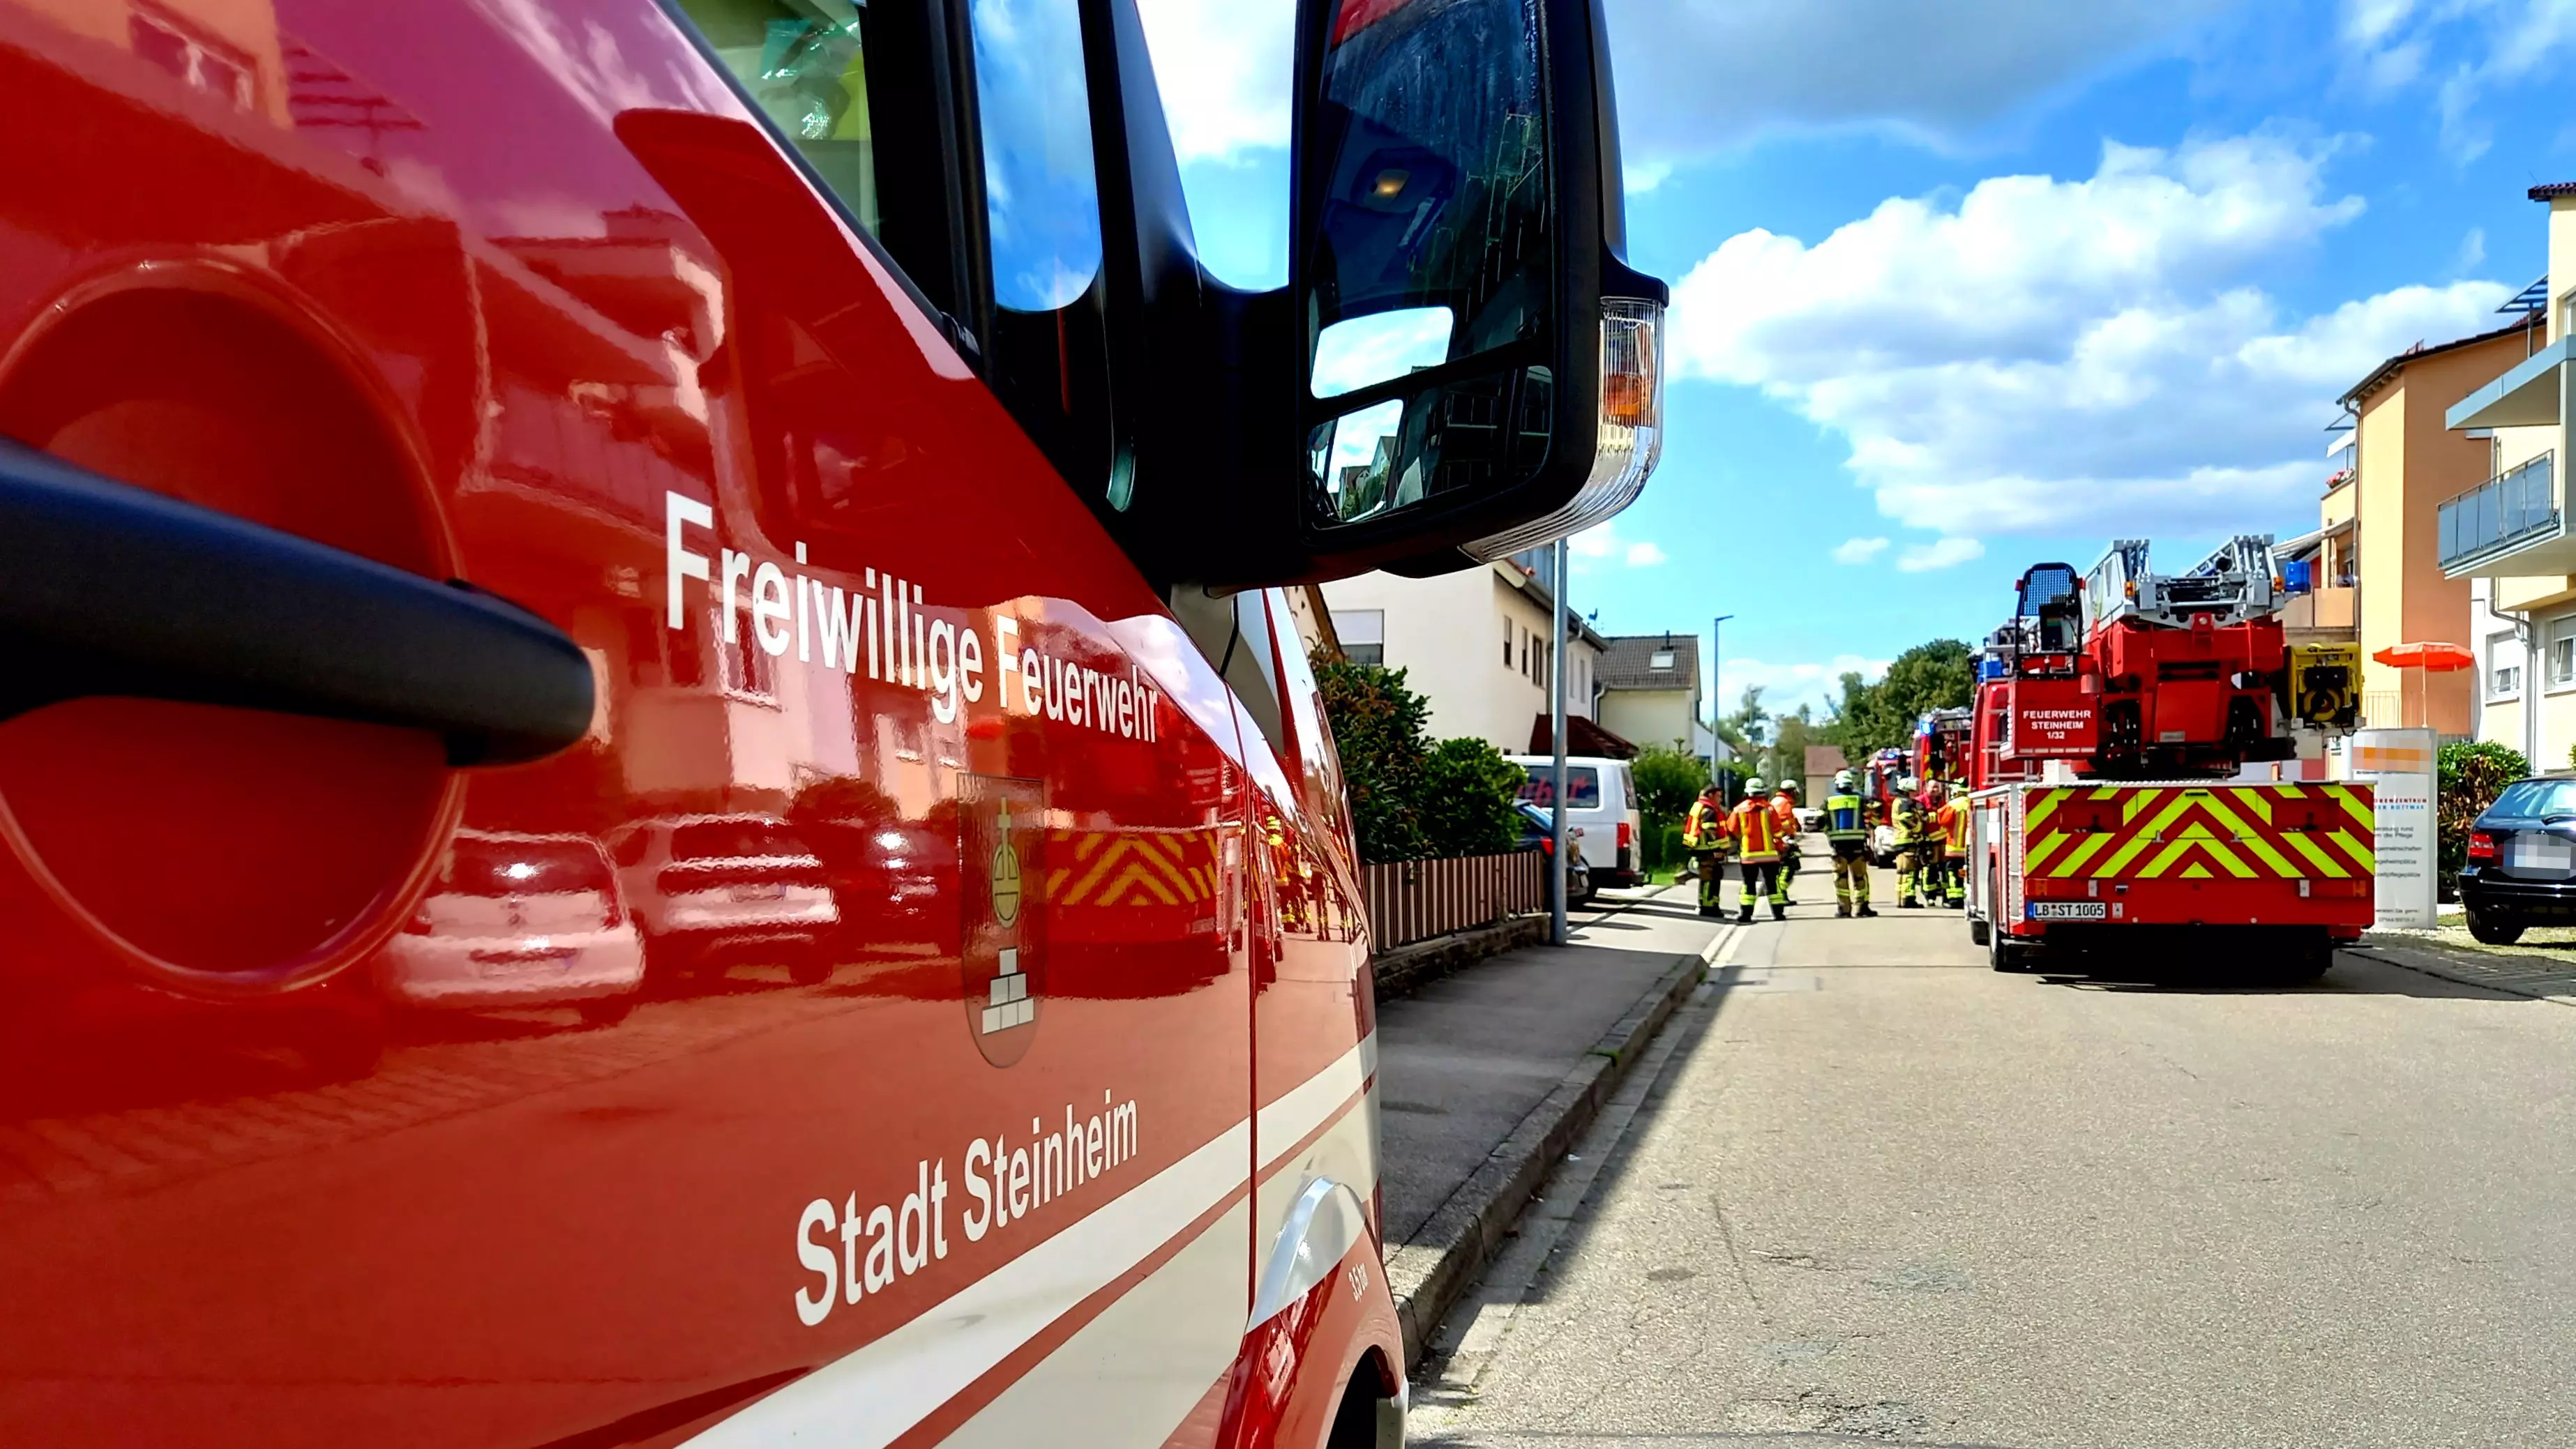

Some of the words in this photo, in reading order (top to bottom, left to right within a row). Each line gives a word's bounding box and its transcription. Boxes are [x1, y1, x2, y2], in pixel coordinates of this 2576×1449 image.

[665, 490, 984, 724] Freiwillige
[995, 614, 1159, 743] Feuerwehr
[2023, 710, 2091, 719] FEUERWEHR
[2031, 721, 2084, 730] STEINHEIM
[2047, 731, 2065, 739] 1/32
[2035, 904, 2049, 916] LB
[2058, 904, 2072, 916] ST
[2075, 904, 2104, 916] 1005
[794, 1157, 949, 1327] Stadt
[963, 1088, 1138, 1243] Steinheim
